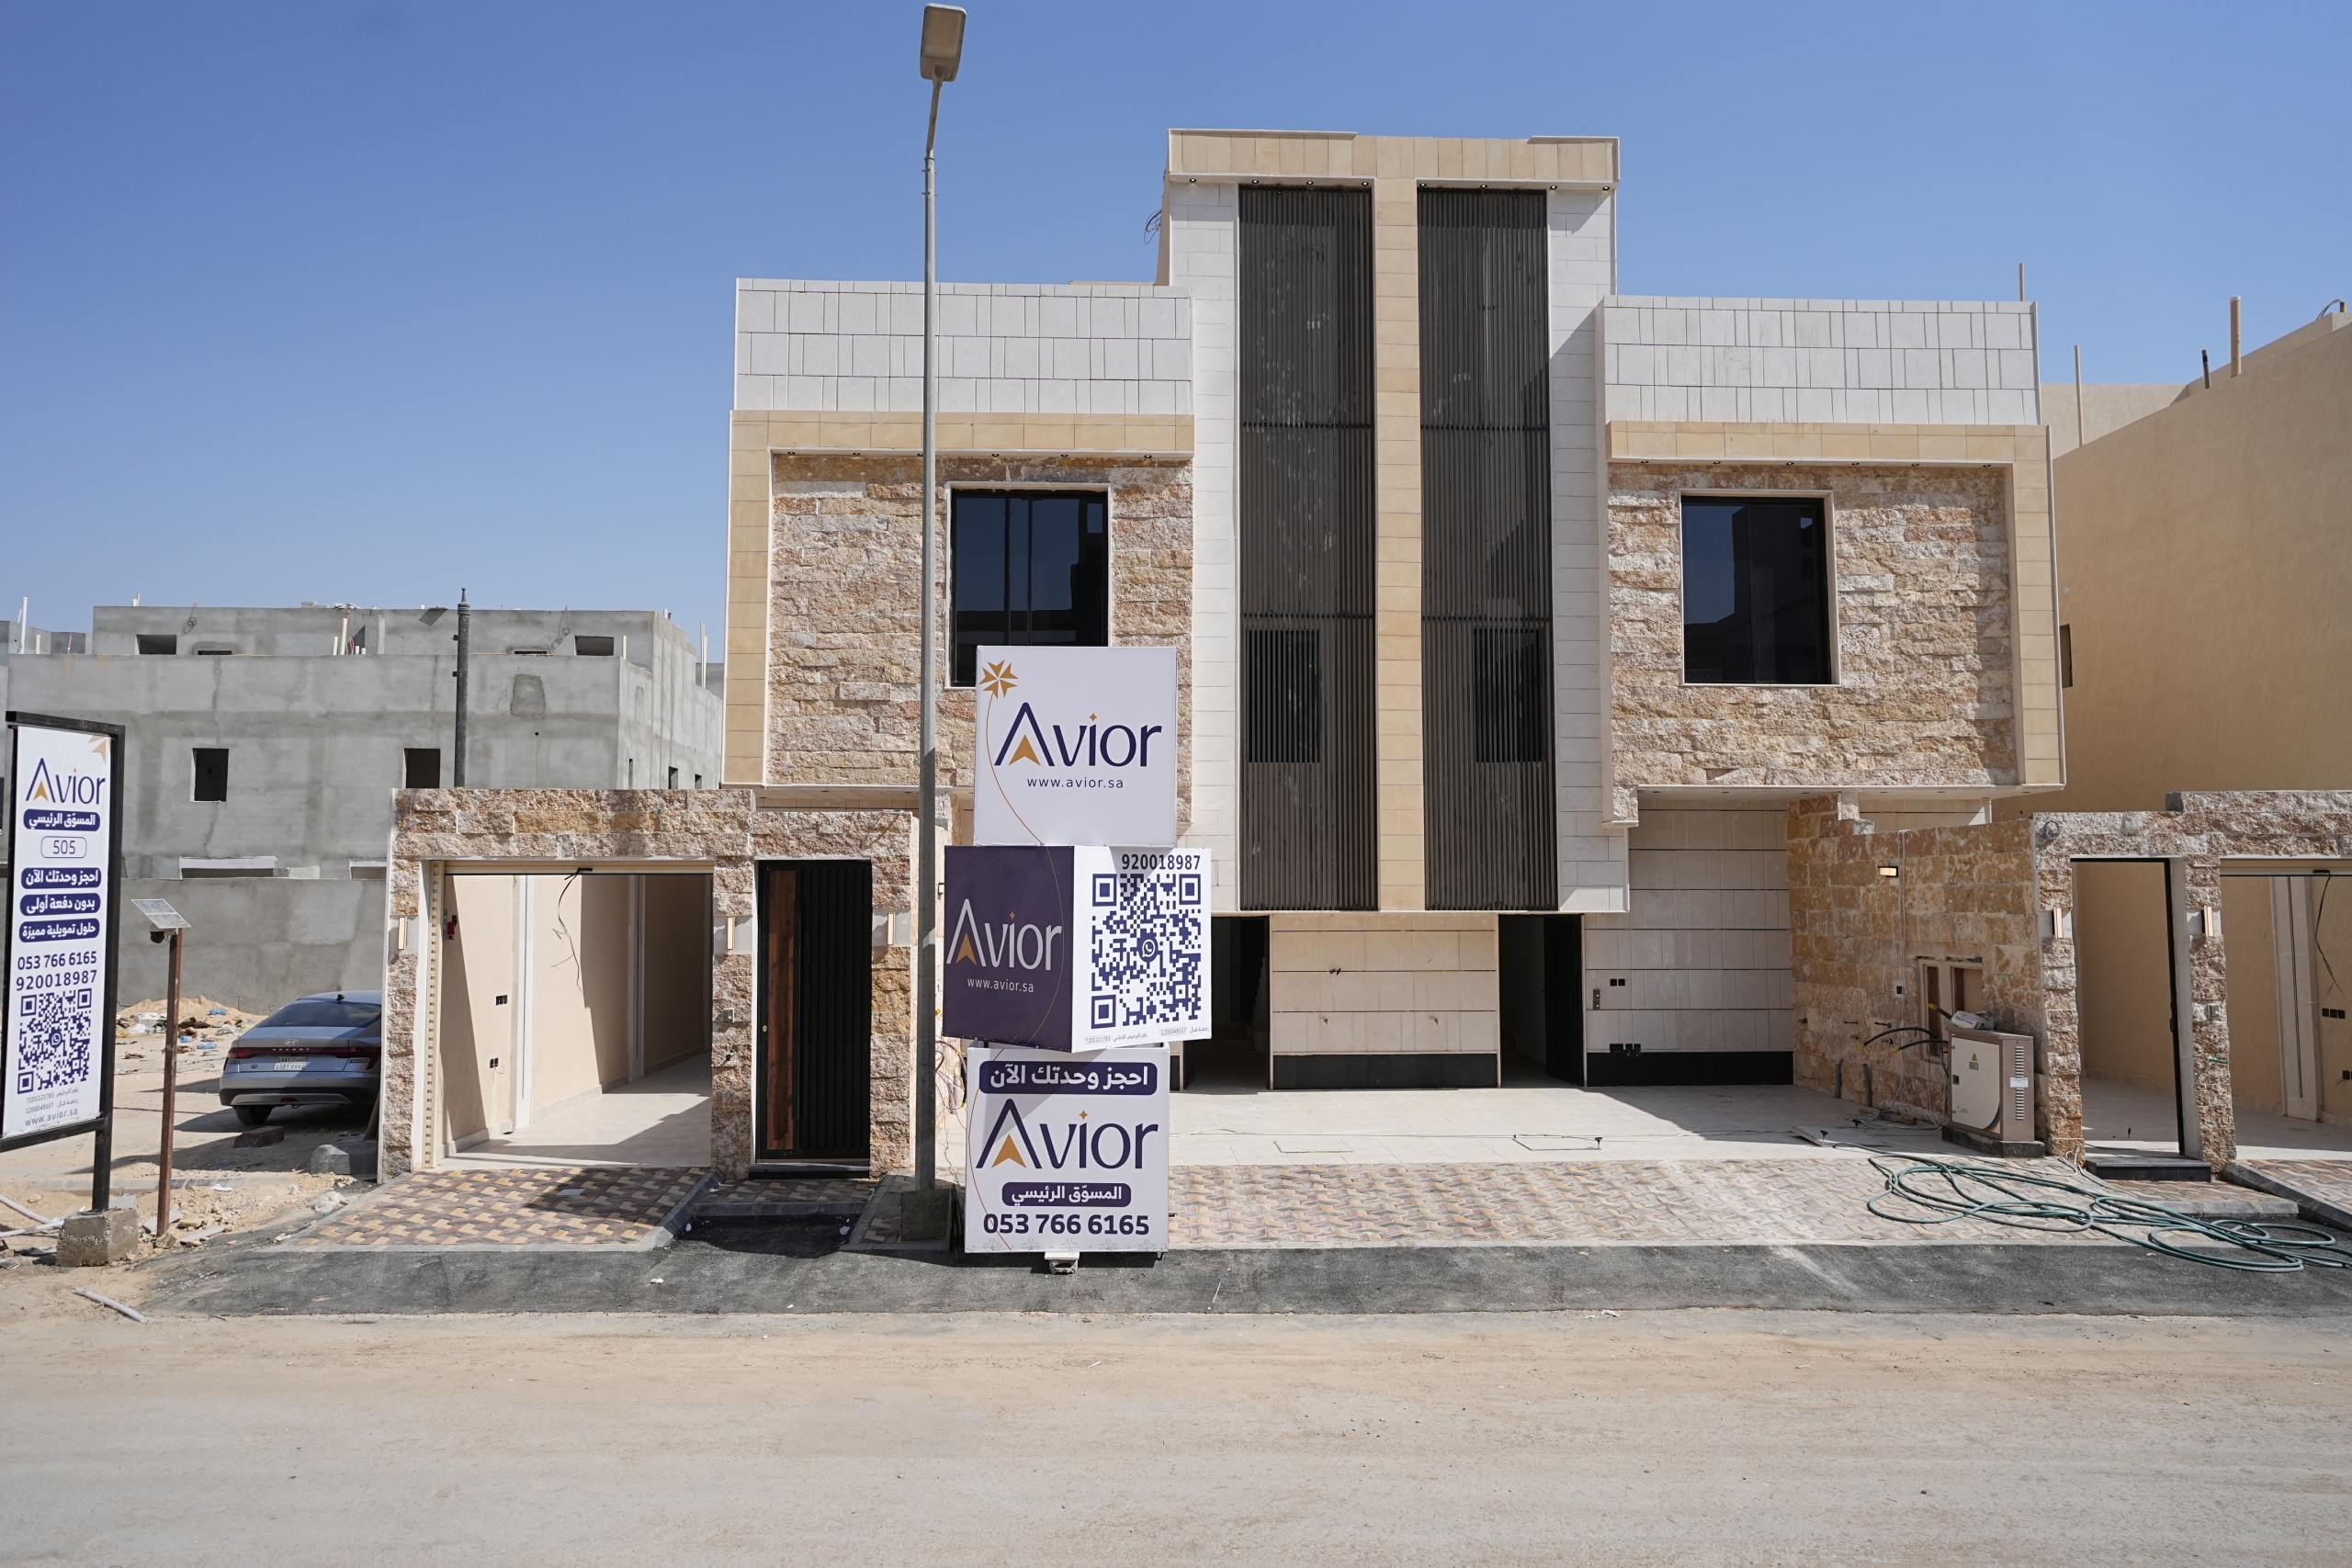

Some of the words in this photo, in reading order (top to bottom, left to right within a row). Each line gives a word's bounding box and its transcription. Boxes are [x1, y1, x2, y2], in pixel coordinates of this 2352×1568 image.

[994, 702, 1162, 767] Avior
[25, 758, 106, 805] Avior
[1027, 776, 1124, 789] www.avior.sa
[28, 813, 63, 829] الرئيسي
[52, 840, 76, 854] 505
[1121, 853, 1201, 870] 920018987
[26, 869, 44, 886] الآن
[45, 870, 77, 886] وحدتك
[78, 869, 99, 886] احجز
[26, 895, 49, 914] أولى
[50, 896, 73, 909] دفعة
[74, 899, 96, 911] بدون
[22, 925, 45, 940] مميزة
[47, 924, 76, 938] تمويلية
[76, 922, 96, 936] حلول
[945, 898, 1062, 971] Avior
[17, 955, 40, 970] 053
[43, 953, 66, 967] 766
[69, 951, 97, 965] 6165
[16, 969, 97, 991] 920018987
[967, 976, 1034, 993] www.avior.sa
[990, 1064, 1026, 1088] الآن
[1031, 1065, 1100, 1090] وحدتك
[1102, 1066, 1148, 1090] احجز
[25, 1108, 78, 1126] www.avior.sa
[976, 1098, 1159, 1169] Avior
[1012, 1185, 1065, 1206] الرئيسي
[983, 1213, 1029, 1234] 053
[1035, 1213, 1081, 1235] 766
[1088, 1214, 1149, 1235] 6165
